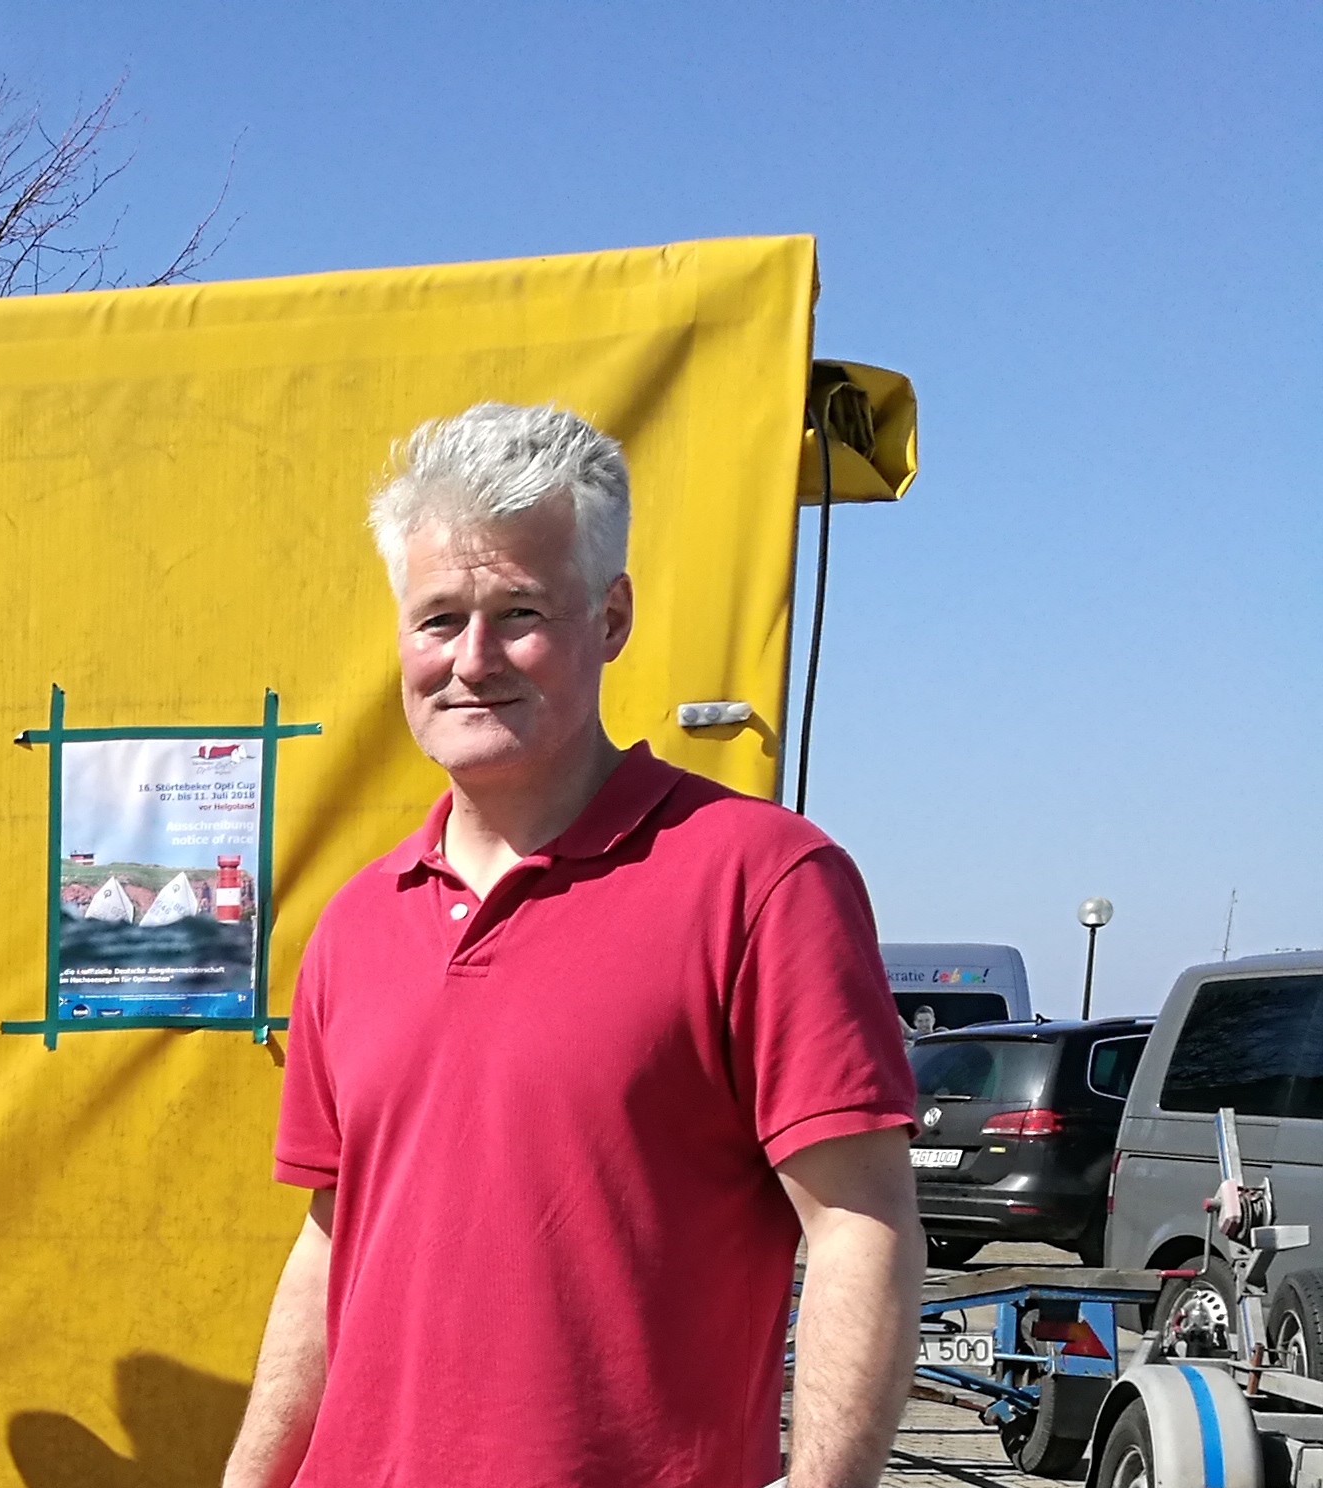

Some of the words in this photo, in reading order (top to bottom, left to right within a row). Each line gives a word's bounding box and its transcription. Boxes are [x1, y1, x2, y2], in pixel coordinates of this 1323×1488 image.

[155, 783, 211, 792] Störtebeker
[214, 782, 234, 791] Opti
[237, 781, 255, 791] Cup
[177, 792, 191, 801] bis
[211, 792, 228, 800] Juli
[231, 791, 255, 799] 2018
[214, 802, 255, 811] Helgoland
[166, 820, 254, 832] Ausschreibung
[171, 834, 208, 845] notice
[212, 833, 225, 844] of
[228, 836, 254, 844] race
[886, 969, 925, 982] kratie
[939, 1337, 989, 1362] 500
